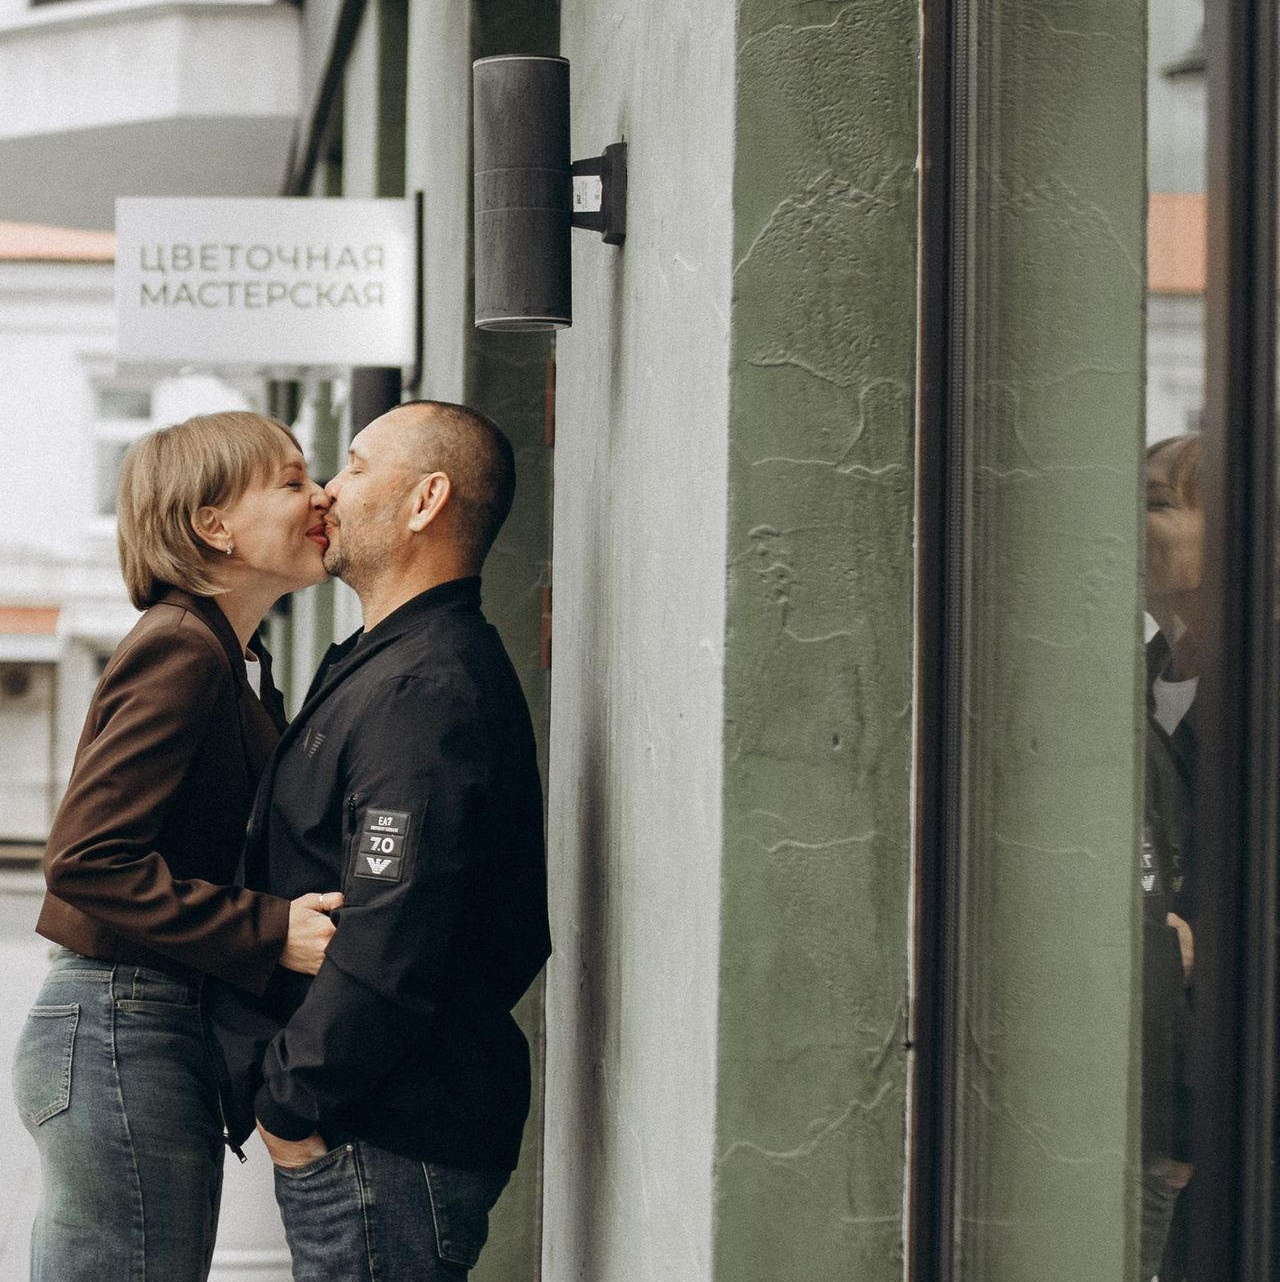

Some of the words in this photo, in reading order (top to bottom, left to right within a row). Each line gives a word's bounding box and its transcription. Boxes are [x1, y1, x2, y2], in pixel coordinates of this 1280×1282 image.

[139, 243, 385, 275] ЦВЕТОЧНАЯ
[139, 281, 385, 309] МАСТЕРСКАЯ
[378, 816, 393, 826] EA7
[370, 836, 394, 853] 7.0
